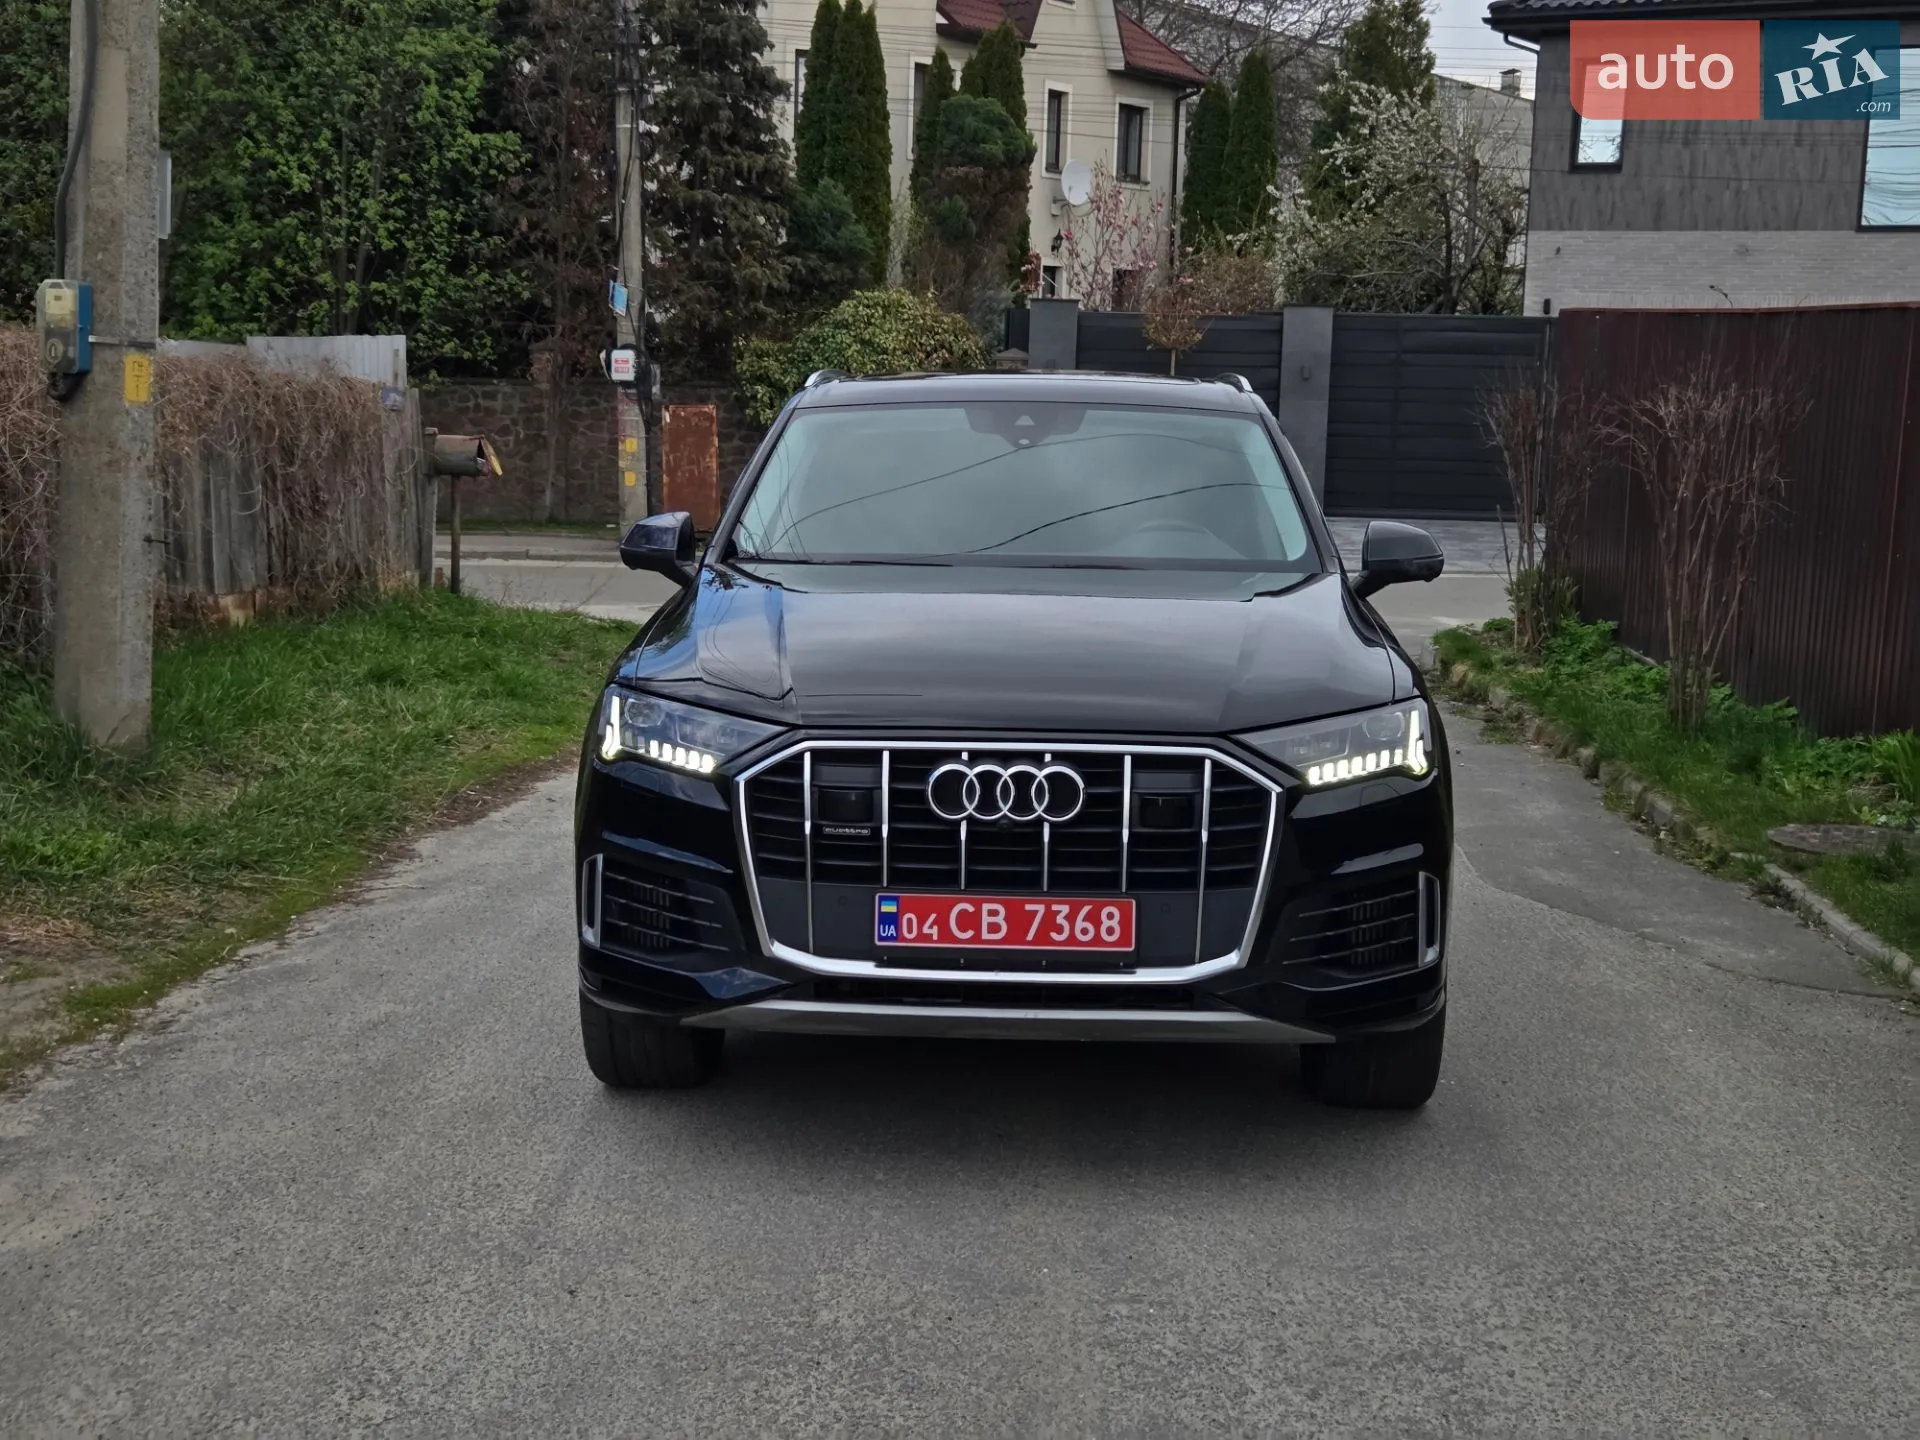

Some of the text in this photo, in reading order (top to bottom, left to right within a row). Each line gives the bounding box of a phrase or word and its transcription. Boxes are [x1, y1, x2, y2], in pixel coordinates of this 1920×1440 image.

[880, 924, 897, 937] UA
[902, 902, 1121, 942] 04 CB 7368
